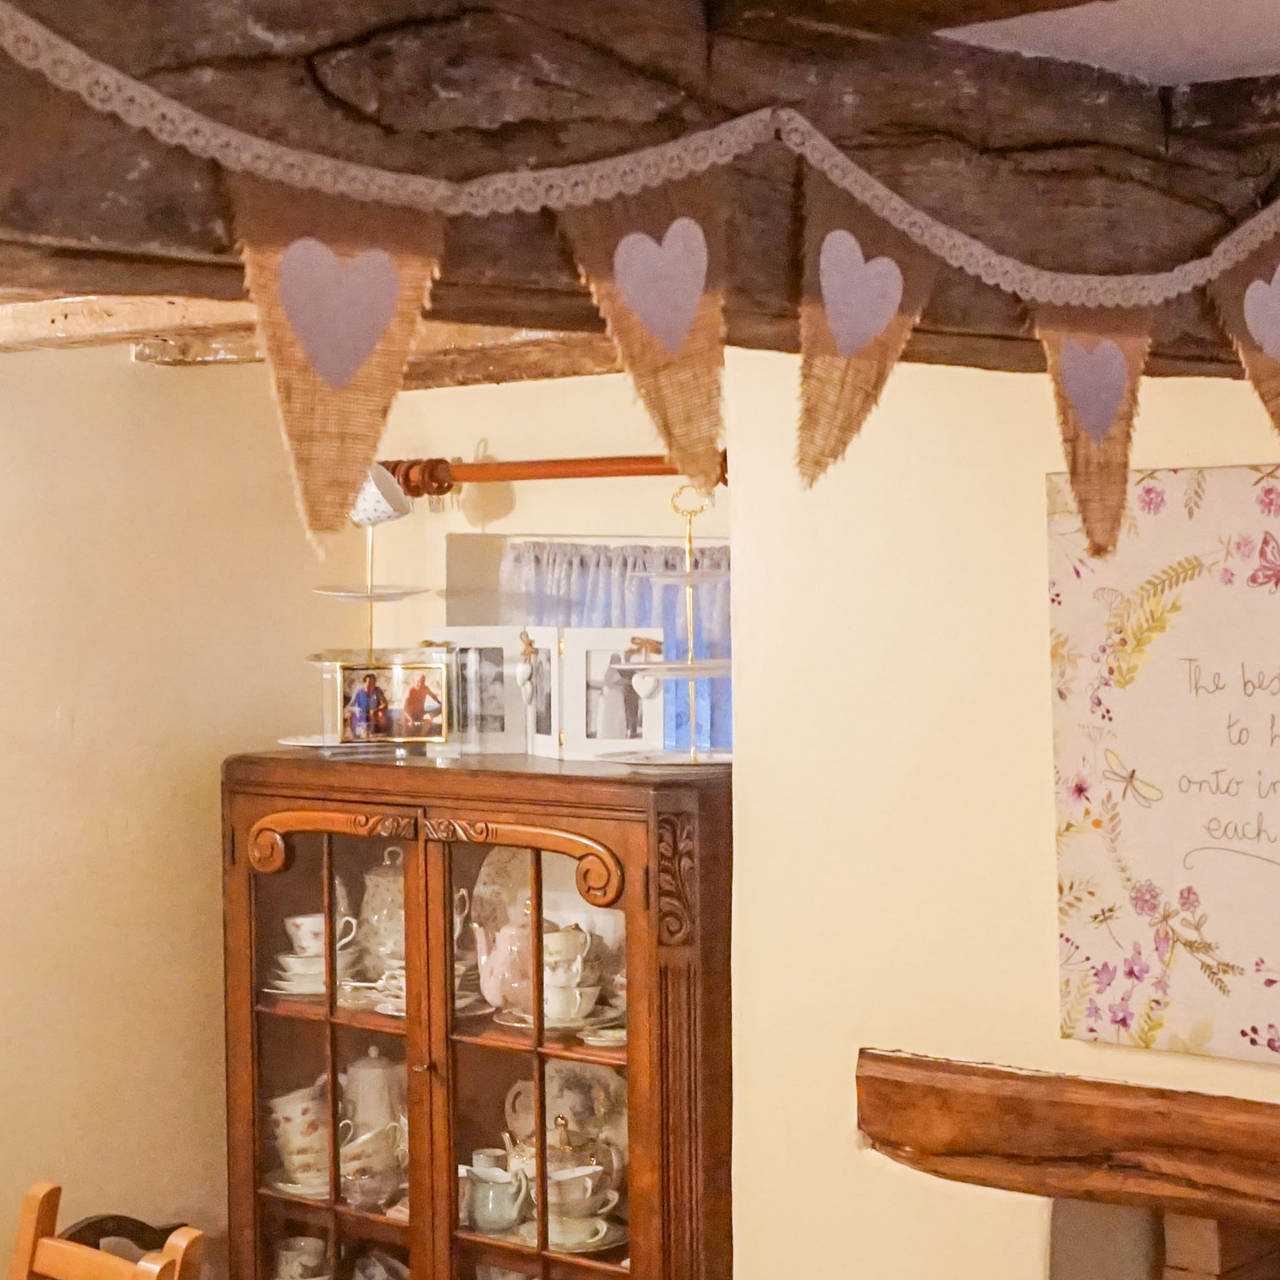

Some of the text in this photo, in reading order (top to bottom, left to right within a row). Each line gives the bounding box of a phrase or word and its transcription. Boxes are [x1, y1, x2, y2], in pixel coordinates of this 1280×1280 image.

[1179, 657, 1226, 696] The
[1227, 711, 1250, 747] to
[1178, 769, 1244, 796] onto
[1204, 811, 1277, 845] each
